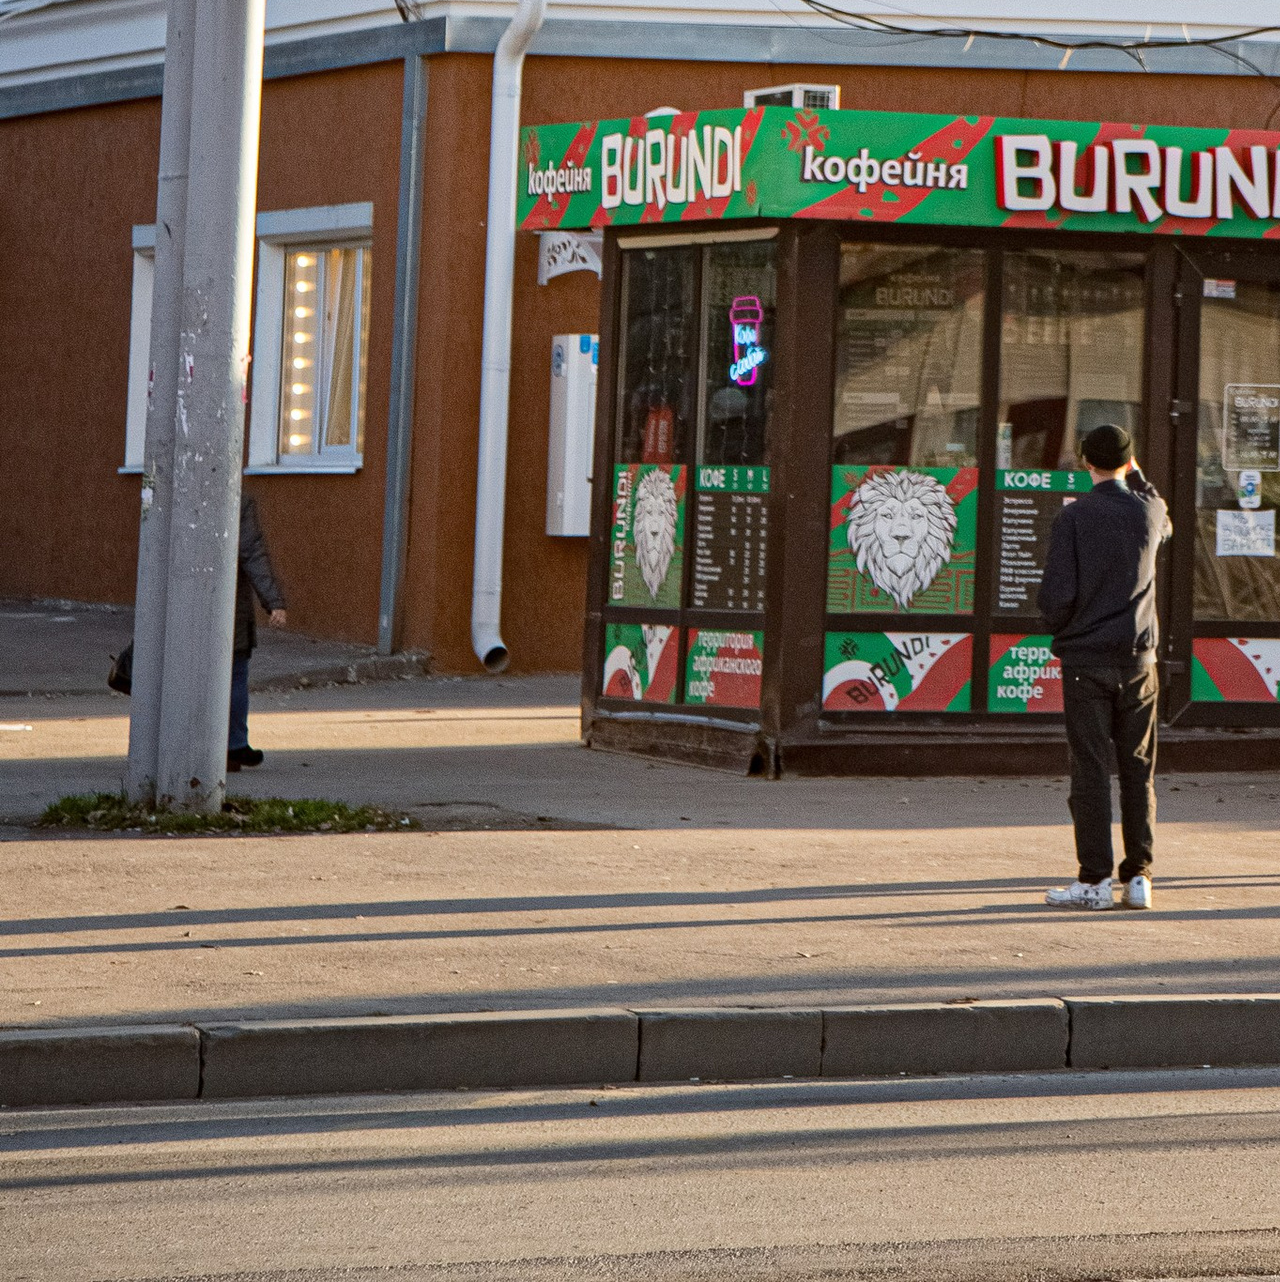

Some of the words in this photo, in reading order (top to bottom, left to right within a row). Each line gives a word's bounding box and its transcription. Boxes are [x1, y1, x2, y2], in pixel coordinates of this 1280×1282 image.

[527, 159, 592, 203] кофейня
[601, 124, 742, 210] BURUNDI
[803, 145, 969, 193] кофейня
[700, 468, 726, 488] КОФЕ
[1003, 471, 1052, 489] КОФЕ
[612, 471, 629, 600] BURUNDI
[846, 634, 931, 705] BURUNDI
[688, 677, 715, 704] кофе
[997, 683, 1044, 703] кофе
